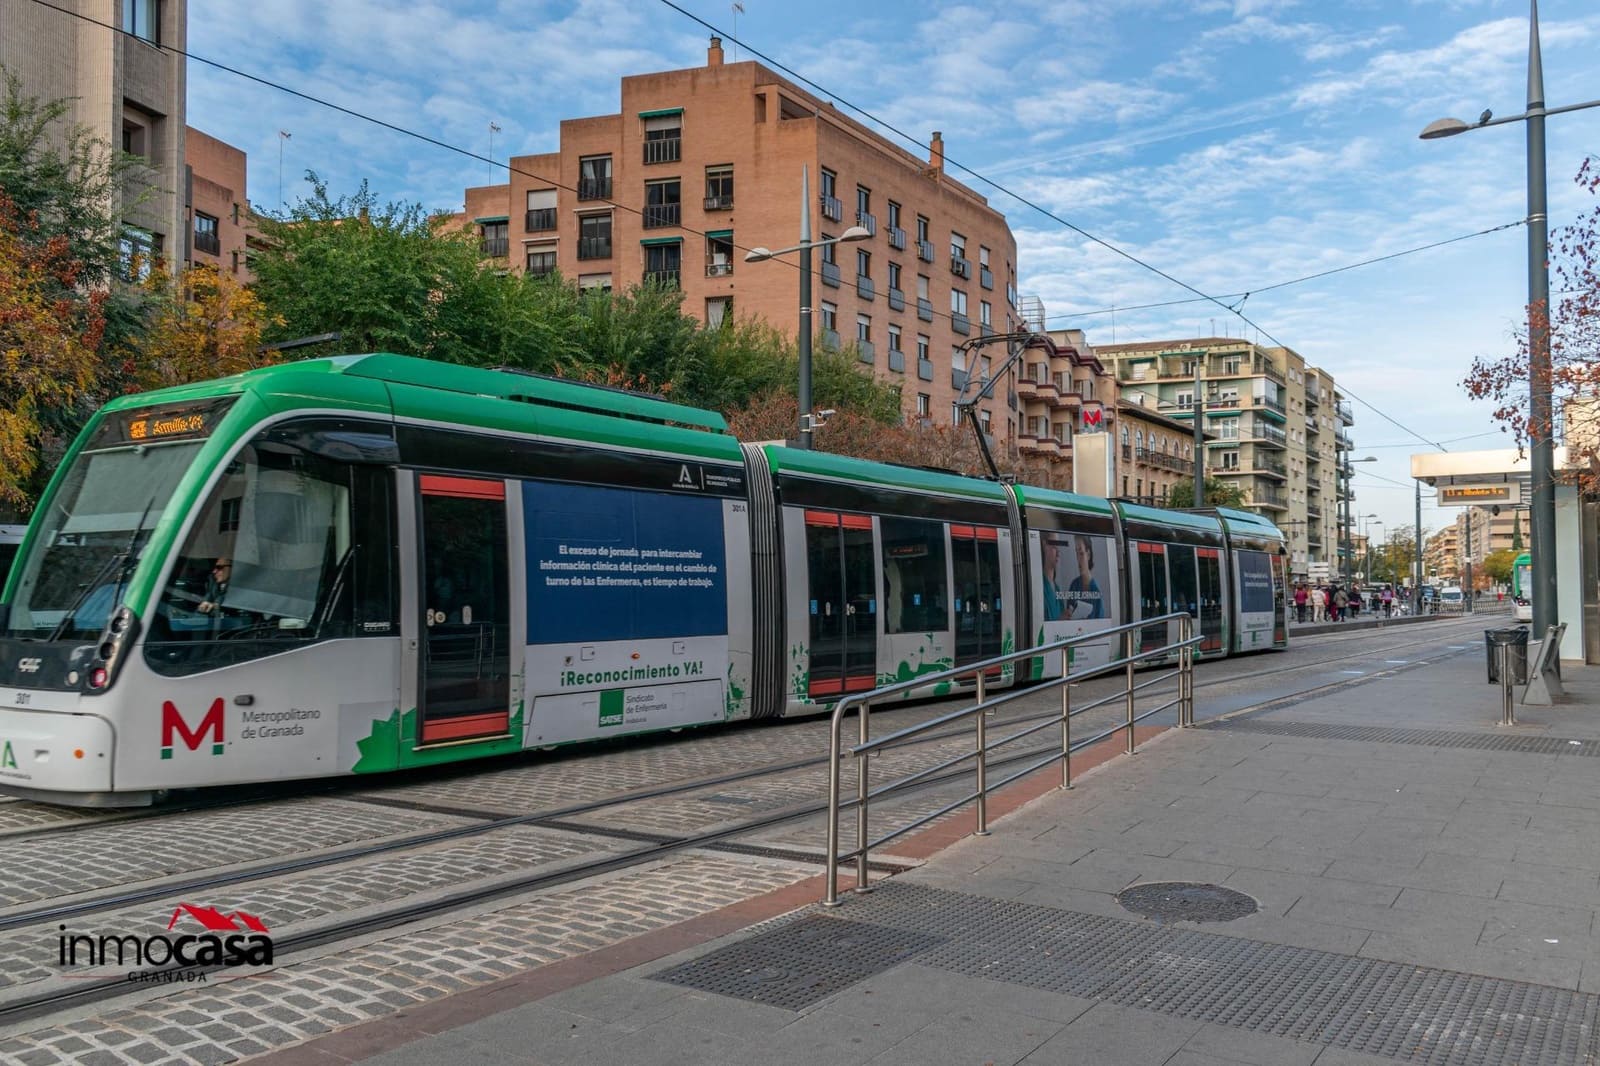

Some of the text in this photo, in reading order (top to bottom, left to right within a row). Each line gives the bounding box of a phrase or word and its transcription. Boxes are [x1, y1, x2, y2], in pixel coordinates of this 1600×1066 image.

[1083, 409, 1103, 428] M
[559, 545, 703, 559] El exceso de jornada para intercambiar
[540, 560, 717, 573] información clínica del paciente en el cambio de
[545, 576, 570, 586] turno
[570, 576, 582, 586] de
[583, 576, 595, 586] las
[596, 576, 643, 587] Enfermeras,
[652, 577, 678, 588] tiempo
[678, 577, 688, 586] de
[688, 577, 714, 588] trabajo.
[561, 661, 703, 686] ¡Reconocimiento YA!
[626, 694, 655, 704] Sindicato
[242, 708, 320, 724] Metropolitano
[626, 706, 634, 714] de
[160, 697, 225, 759] M
[241, 724, 304, 739] de Granada
